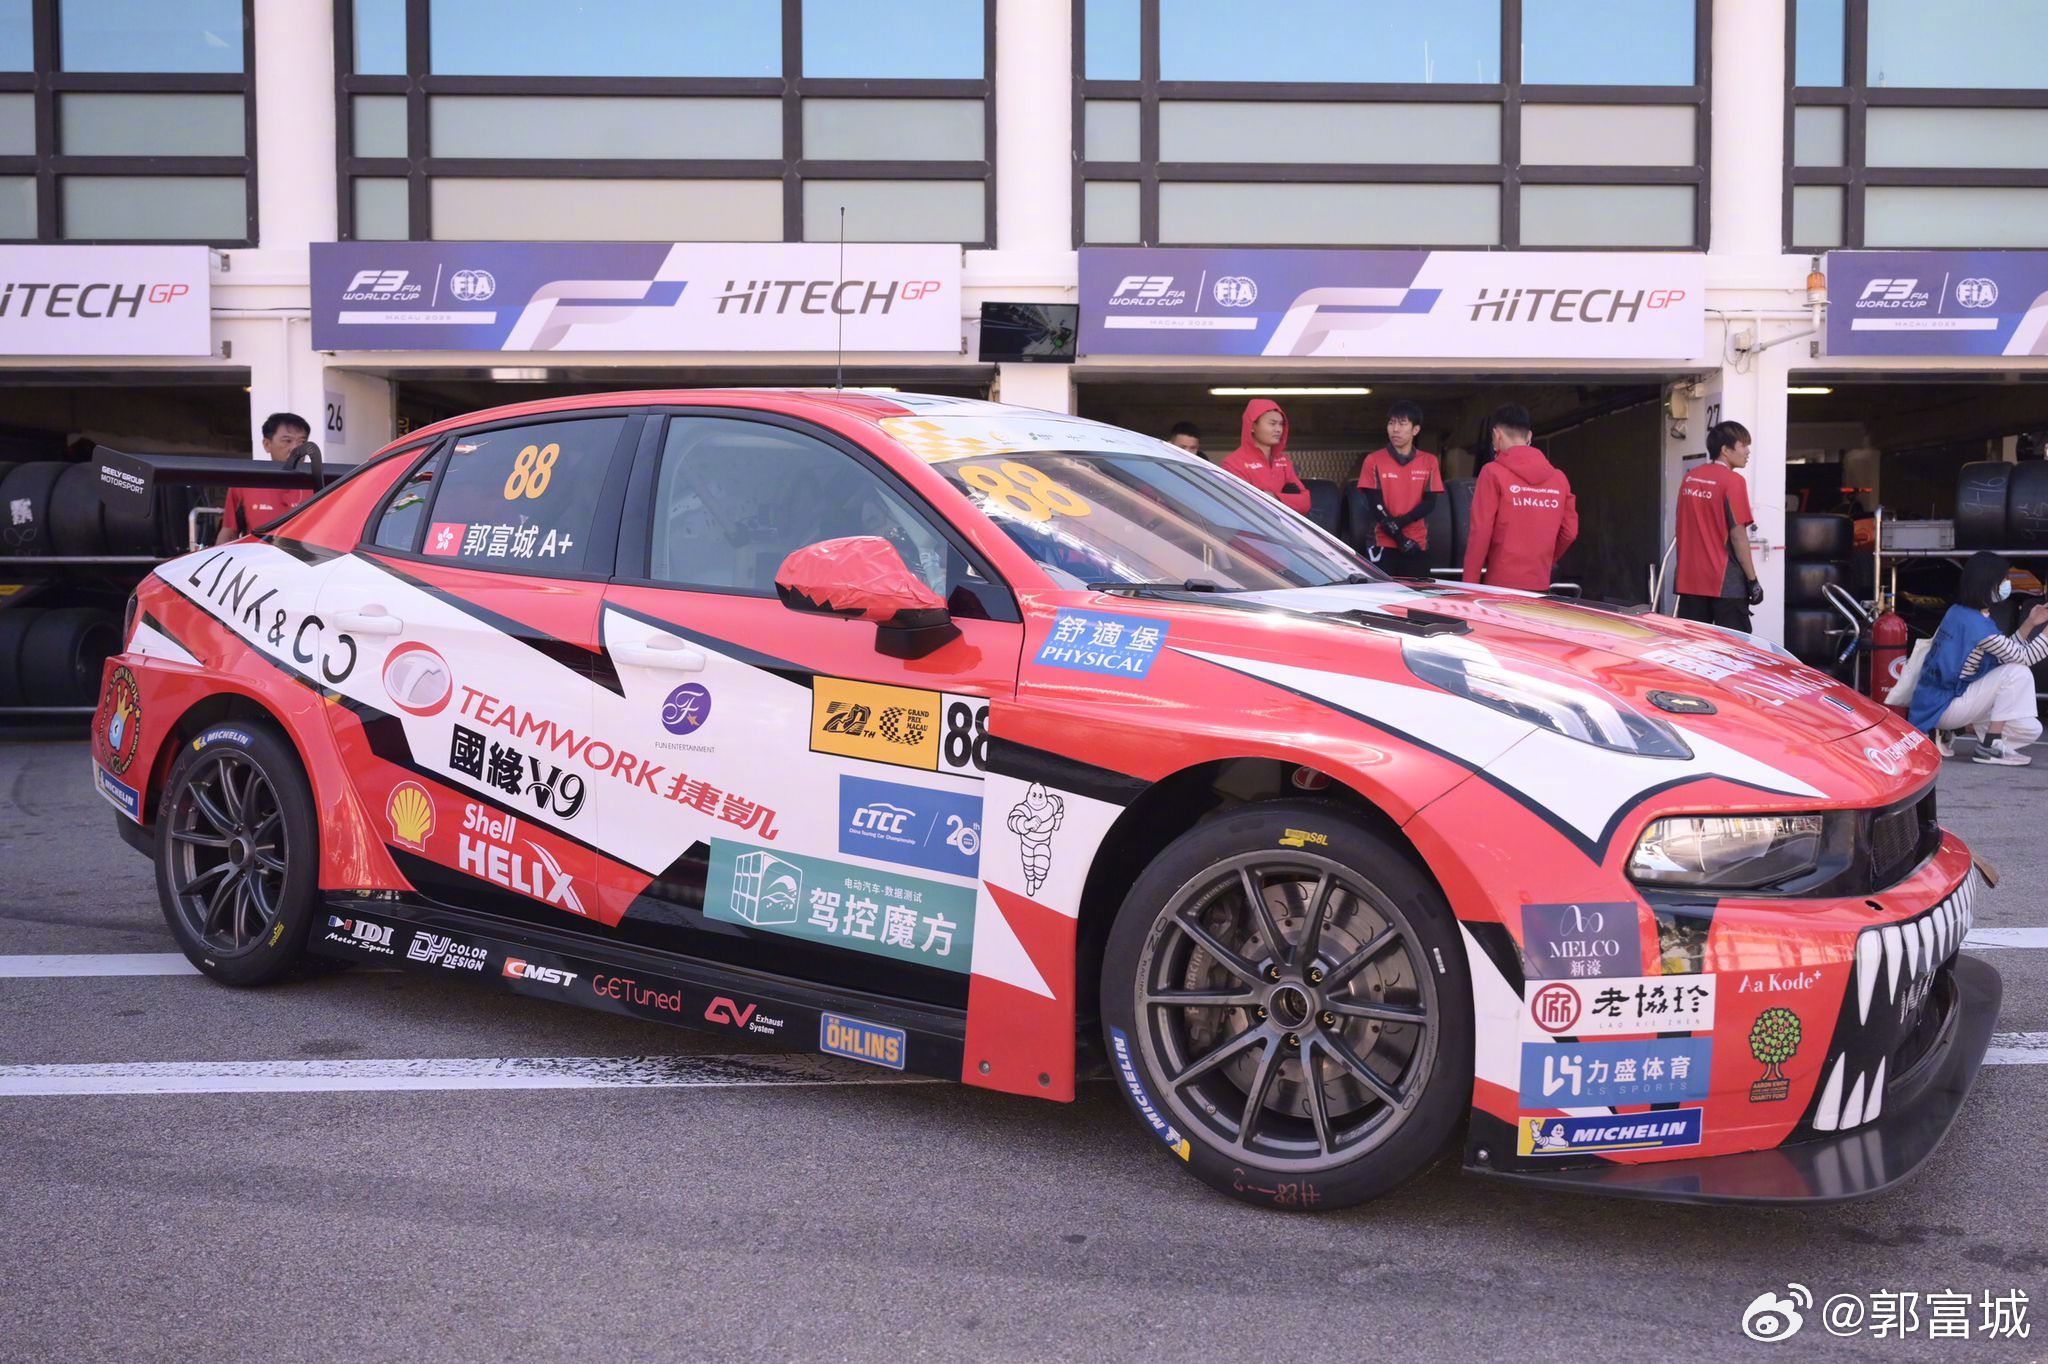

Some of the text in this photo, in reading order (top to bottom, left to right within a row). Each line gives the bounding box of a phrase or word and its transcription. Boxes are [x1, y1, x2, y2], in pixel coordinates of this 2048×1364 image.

[346, 270, 409, 292] F3
[900, 281, 941, 300] GP
[1113, 276, 1186, 298] F3 FIA
[1860, 279, 1929, 300] F3 FIA
[149, 284, 189, 303] GP
[1109, 298, 1184, 306] WORLD CUP
[1647, 290, 1686, 309] GP
[1856, 300, 1927, 308] WORLD CUP
[327, 403, 343, 431] 26
[1707, 404, 1720, 432] 27
[101, 466, 145, 485] GEELY GROUP
[504, 443, 560, 500] 88
[100, 474, 144, 494] MOTORSPORT
[958, 462, 1092, 522] 88
[464, 523, 573, 558] 郭富城 A+
[1053, 615, 1159, 652] 舒適堡
[1041, 646, 1144, 673] PHYSICAL
[907, 716, 922, 724] PRIX
[908, 708, 929, 718] GRAND
[206, 731, 249, 745] MICHELIN
[906, 723, 928, 732] MACAU
[459, 685, 668, 793] TEAMWORK
[105, 779, 134, 806] MICHELIN
[462, 803, 517, 845] Shell
[852, 807, 907, 834] CTCC
[458, 833, 587, 915] HELIX
[352, 919, 394, 946] IDI
[808, 888, 957, 956] 驾控魔方
[325, 932, 394, 955] Motor Sports
[450, 943, 487, 960] COLOR
[1550, 940, 1620, 958] MELCO
[443, 954, 485, 971] DESIGN
[1571, 960, 1602, 977] 新濠
[507, 962, 578, 987] CMST
[1738, 975, 1763, 993] Aa
[1592, 984, 1709, 1018] 老協珍
[749, 1022, 774, 1035] System
[755, 1014, 784, 1028] Exhaust
[827, 1018, 900, 1063] ÖHLINS
[1587, 1055, 1692, 1084] 力盛体育
[1113, 1035, 1166, 1131] MICHELIN
[1586, 1082, 1688, 1096] LS SPORTS
[1571, 1120, 1688, 1143] MICHELIN
